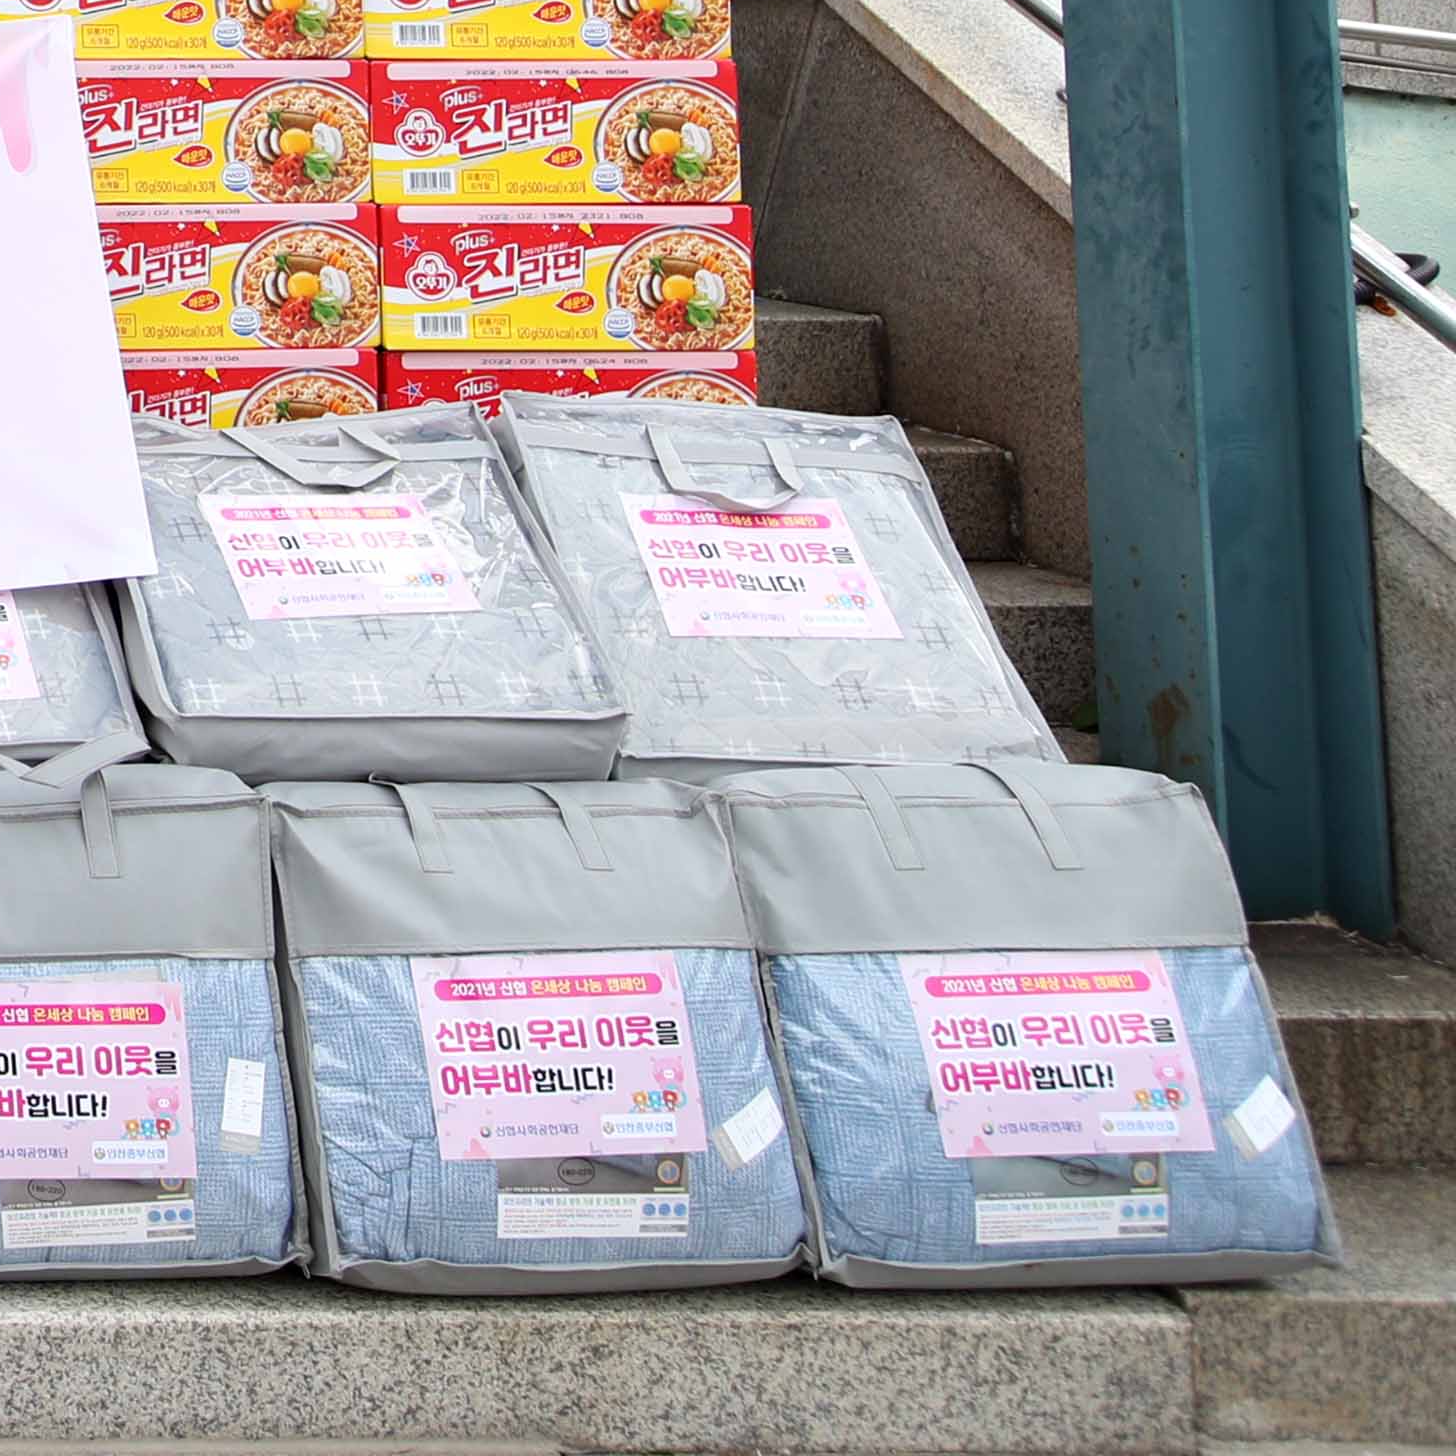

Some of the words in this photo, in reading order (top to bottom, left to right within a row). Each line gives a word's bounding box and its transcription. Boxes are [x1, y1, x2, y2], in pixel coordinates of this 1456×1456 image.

[453, 101, 571, 155] 진라면
[463, 246, 583, 300] 진라면
[2, 1008, 29, 1022] 신협
[33, 1008, 73, 1022] 온세상
[78, 1007, 104, 1022] 나눔
[931, 1017, 1015, 1049] 신협이
[1022, 1015, 1082, 1046] 우리
[1091, 1013, 1176, 1043] 이웃을
[435, 1021, 521, 1053] 신협이
[527, 1018, 587, 1049] 우리
[597, 1015, 680, 1048] 이웃을
[25, 1047, 84, 1076] 우리
[95, 1046, 177, 1076] 이웃을
[940, 1061, 1114, 1092] 어부바합니다!
[441, 1064, 614, 1095] 어부바합니다!
